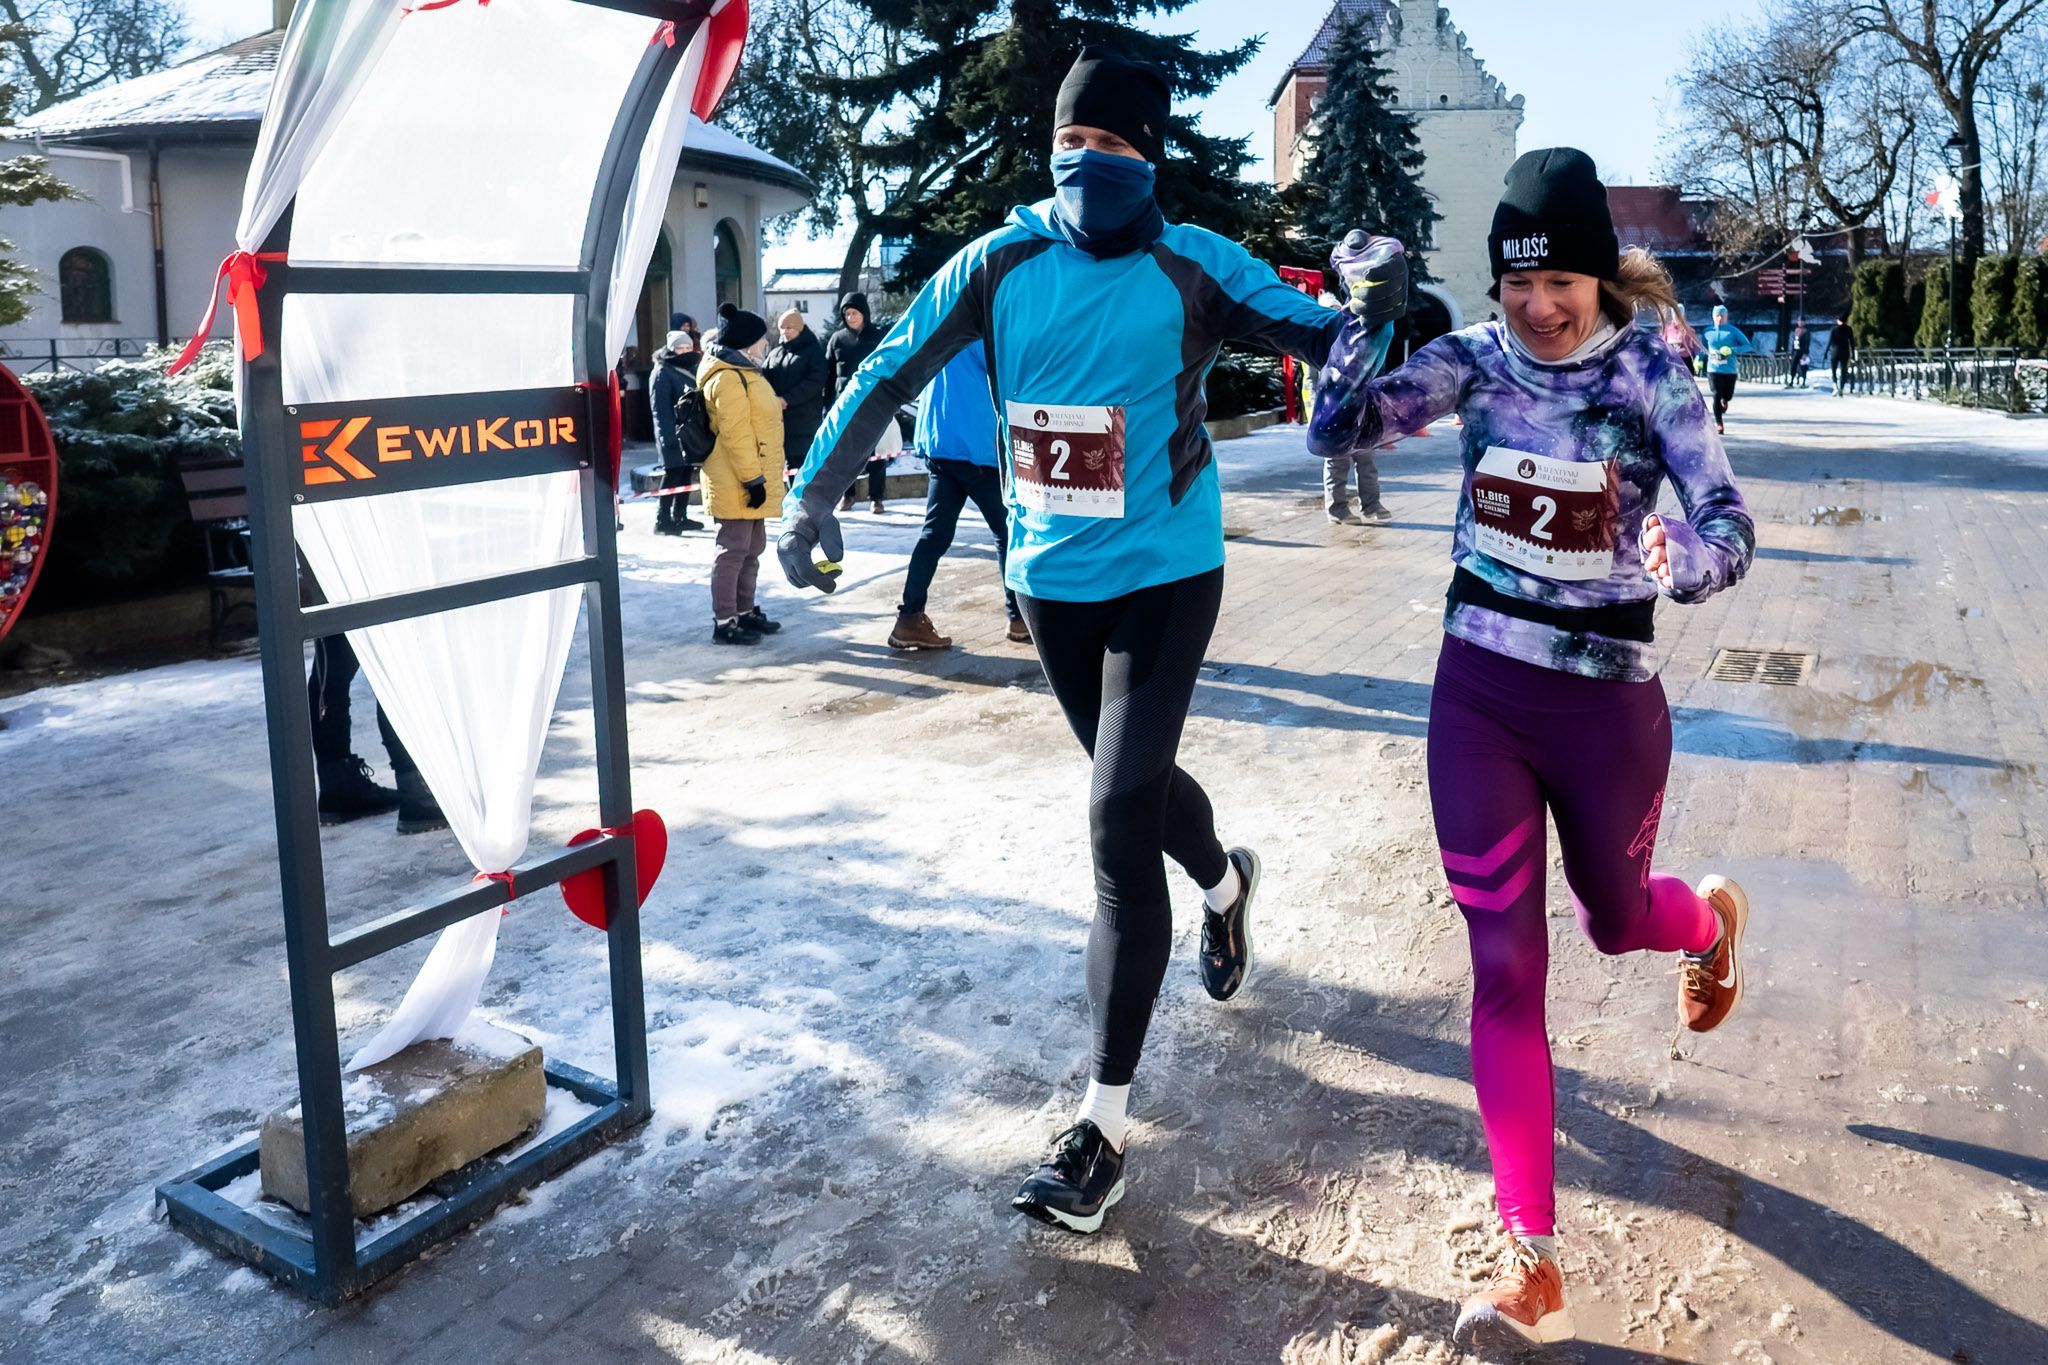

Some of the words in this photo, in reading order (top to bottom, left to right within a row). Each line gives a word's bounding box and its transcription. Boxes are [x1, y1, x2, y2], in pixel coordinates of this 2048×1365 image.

[1503, 232, 1549, 259] MIŁOŚĆ
[1050, 439, 1071, 481] 2
[1475, 488, 1511, 504] 11.BIEG
[1530, 495, 1557, 541] 2
